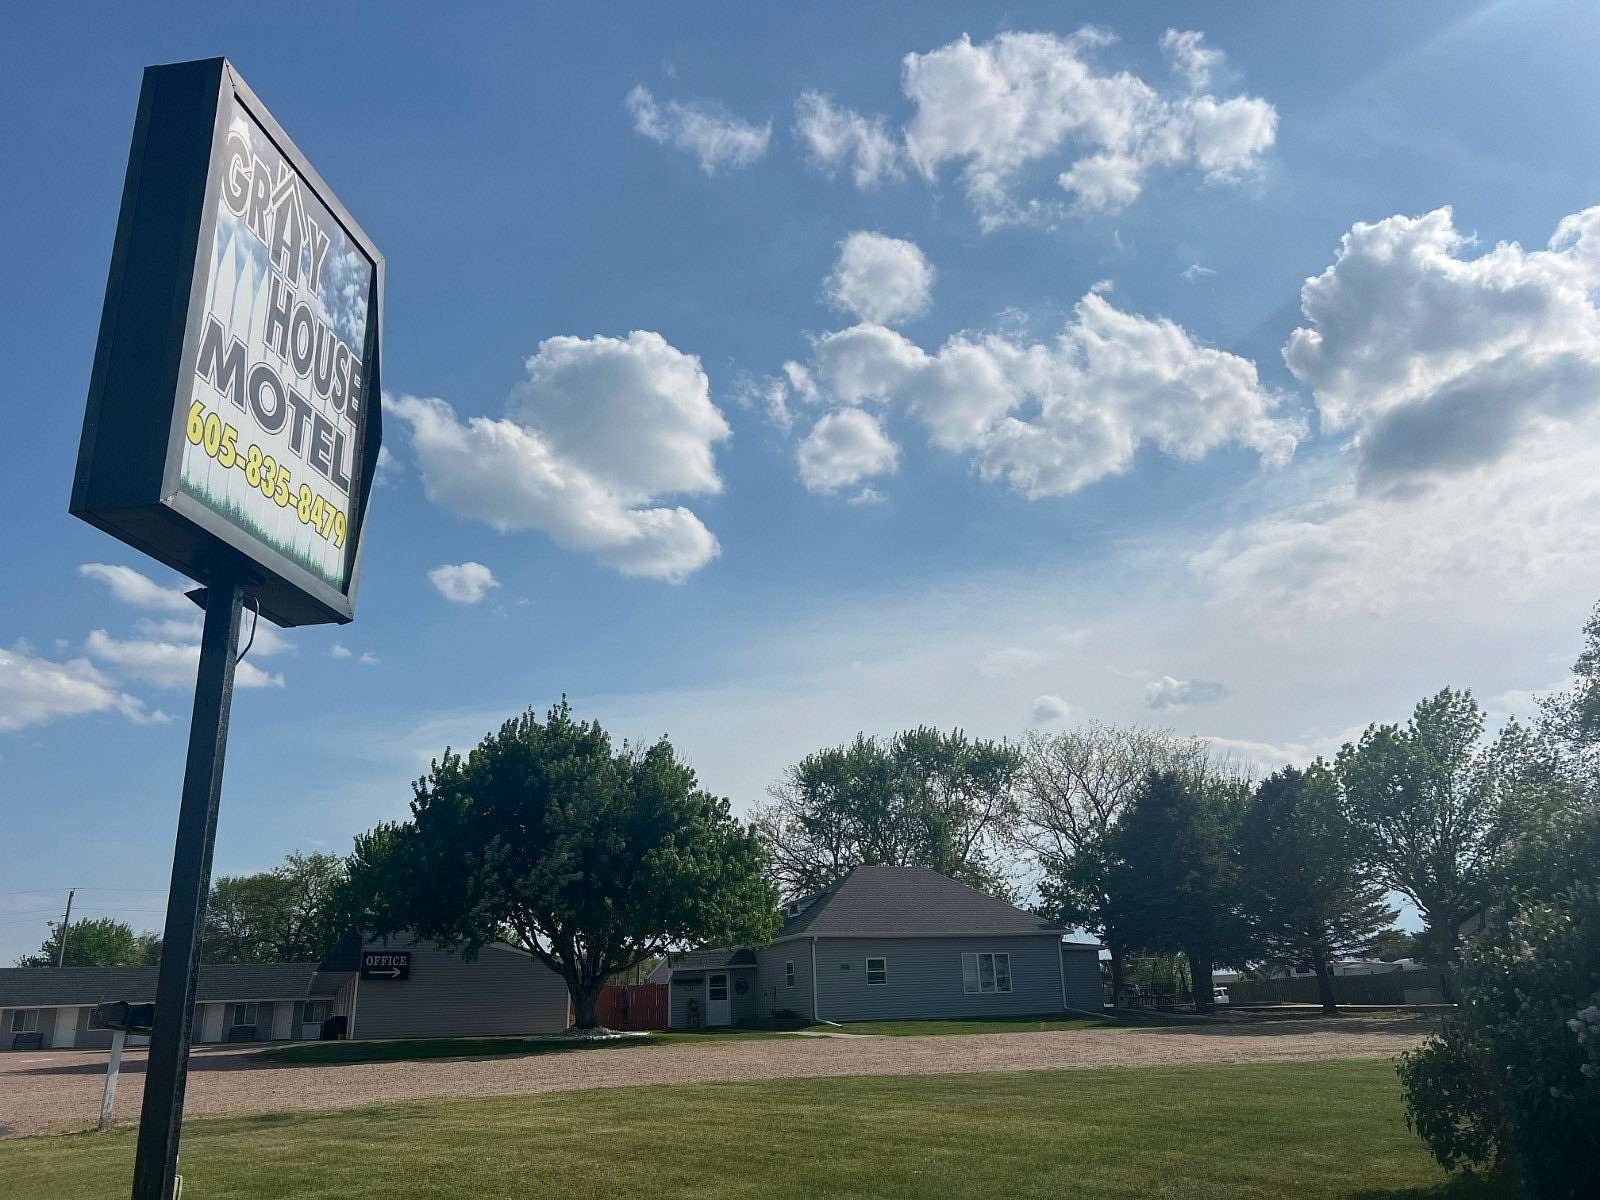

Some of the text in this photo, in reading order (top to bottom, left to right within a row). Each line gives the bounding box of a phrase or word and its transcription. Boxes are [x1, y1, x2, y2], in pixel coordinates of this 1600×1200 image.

[221, 131, 331, 299] GRAY
[193, 311, 351, 497] MOTEL
[263, 270, 363, 428] HOUSE
[185, 399, 348, 549] 605-835-8479
[366, 955, 407, 966] OFFICE
